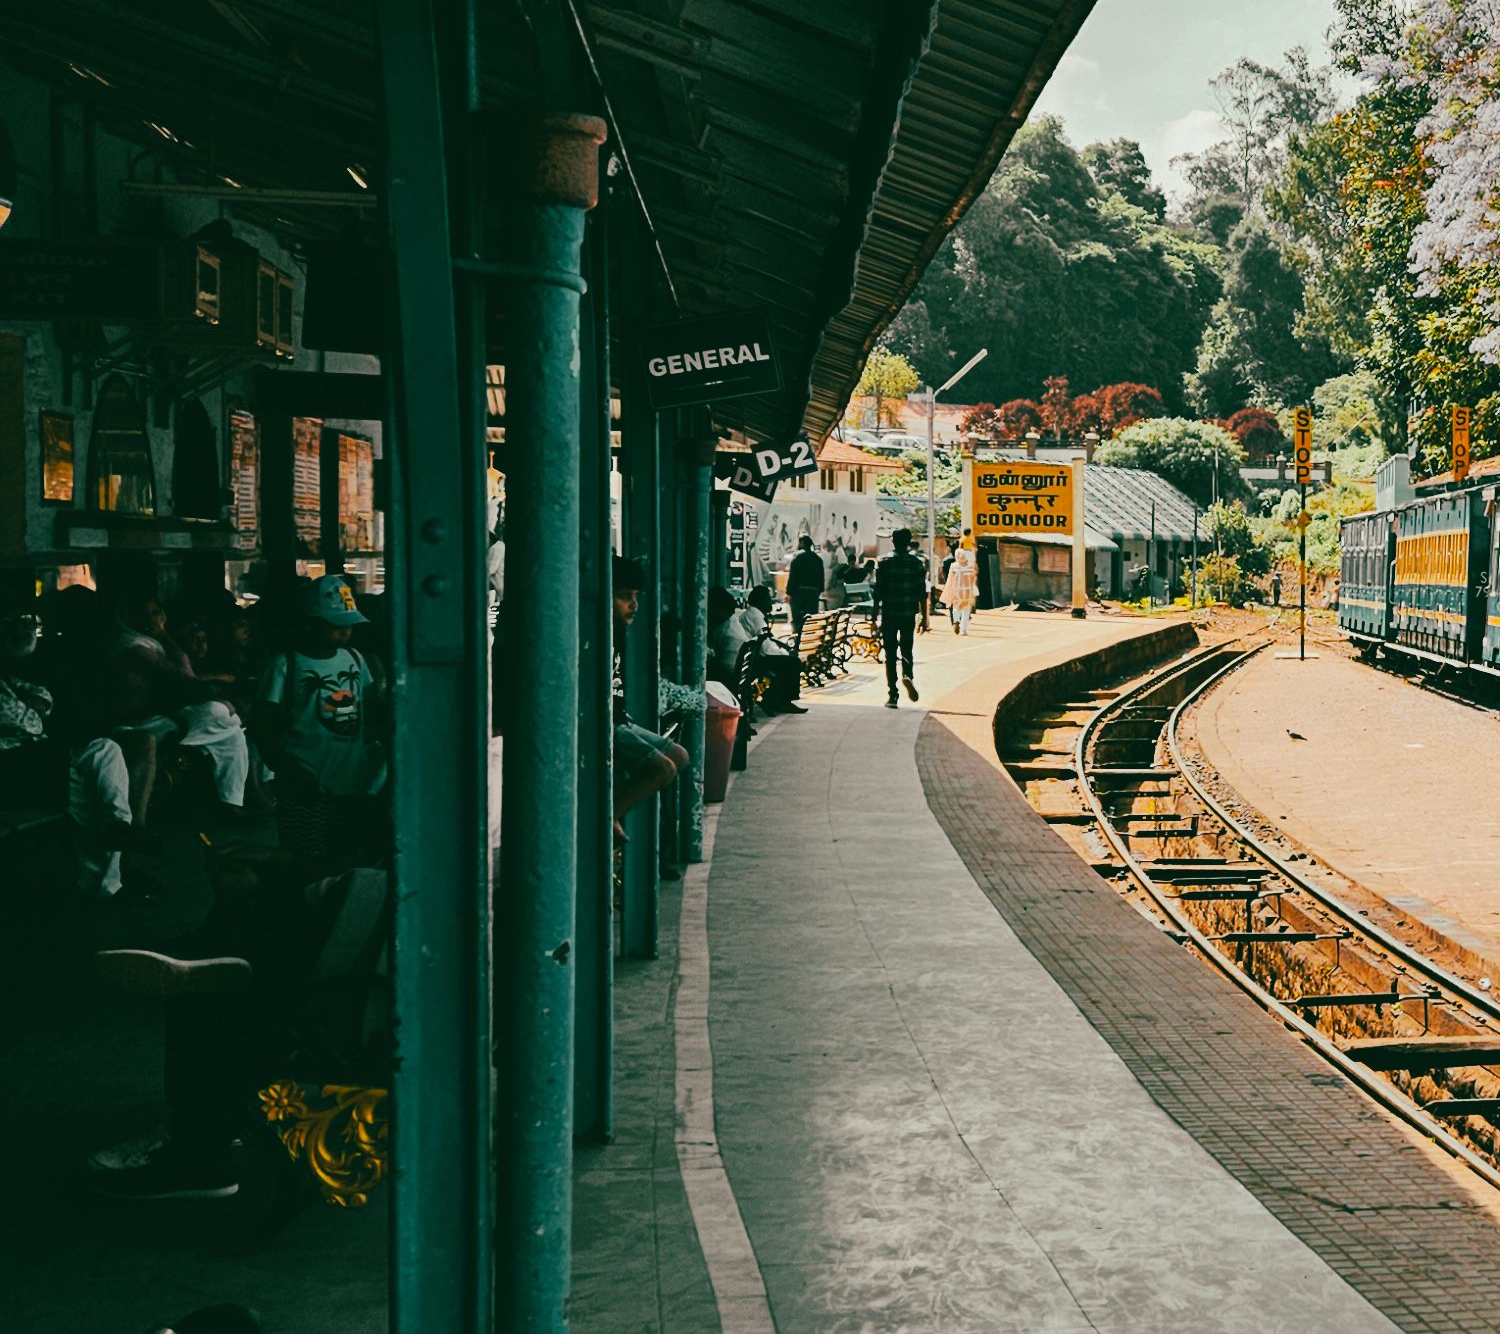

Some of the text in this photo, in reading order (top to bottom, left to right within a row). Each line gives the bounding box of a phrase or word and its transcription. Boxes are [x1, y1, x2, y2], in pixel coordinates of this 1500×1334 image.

[648, 342, 770, 377] GENERAL
[755, 441, 814, 478] D-2
[1296, 410, 1311, 483] STOP
[1454, 410, 1467, 473] STOP
[976, 513, 1068, 528] COONOOR
